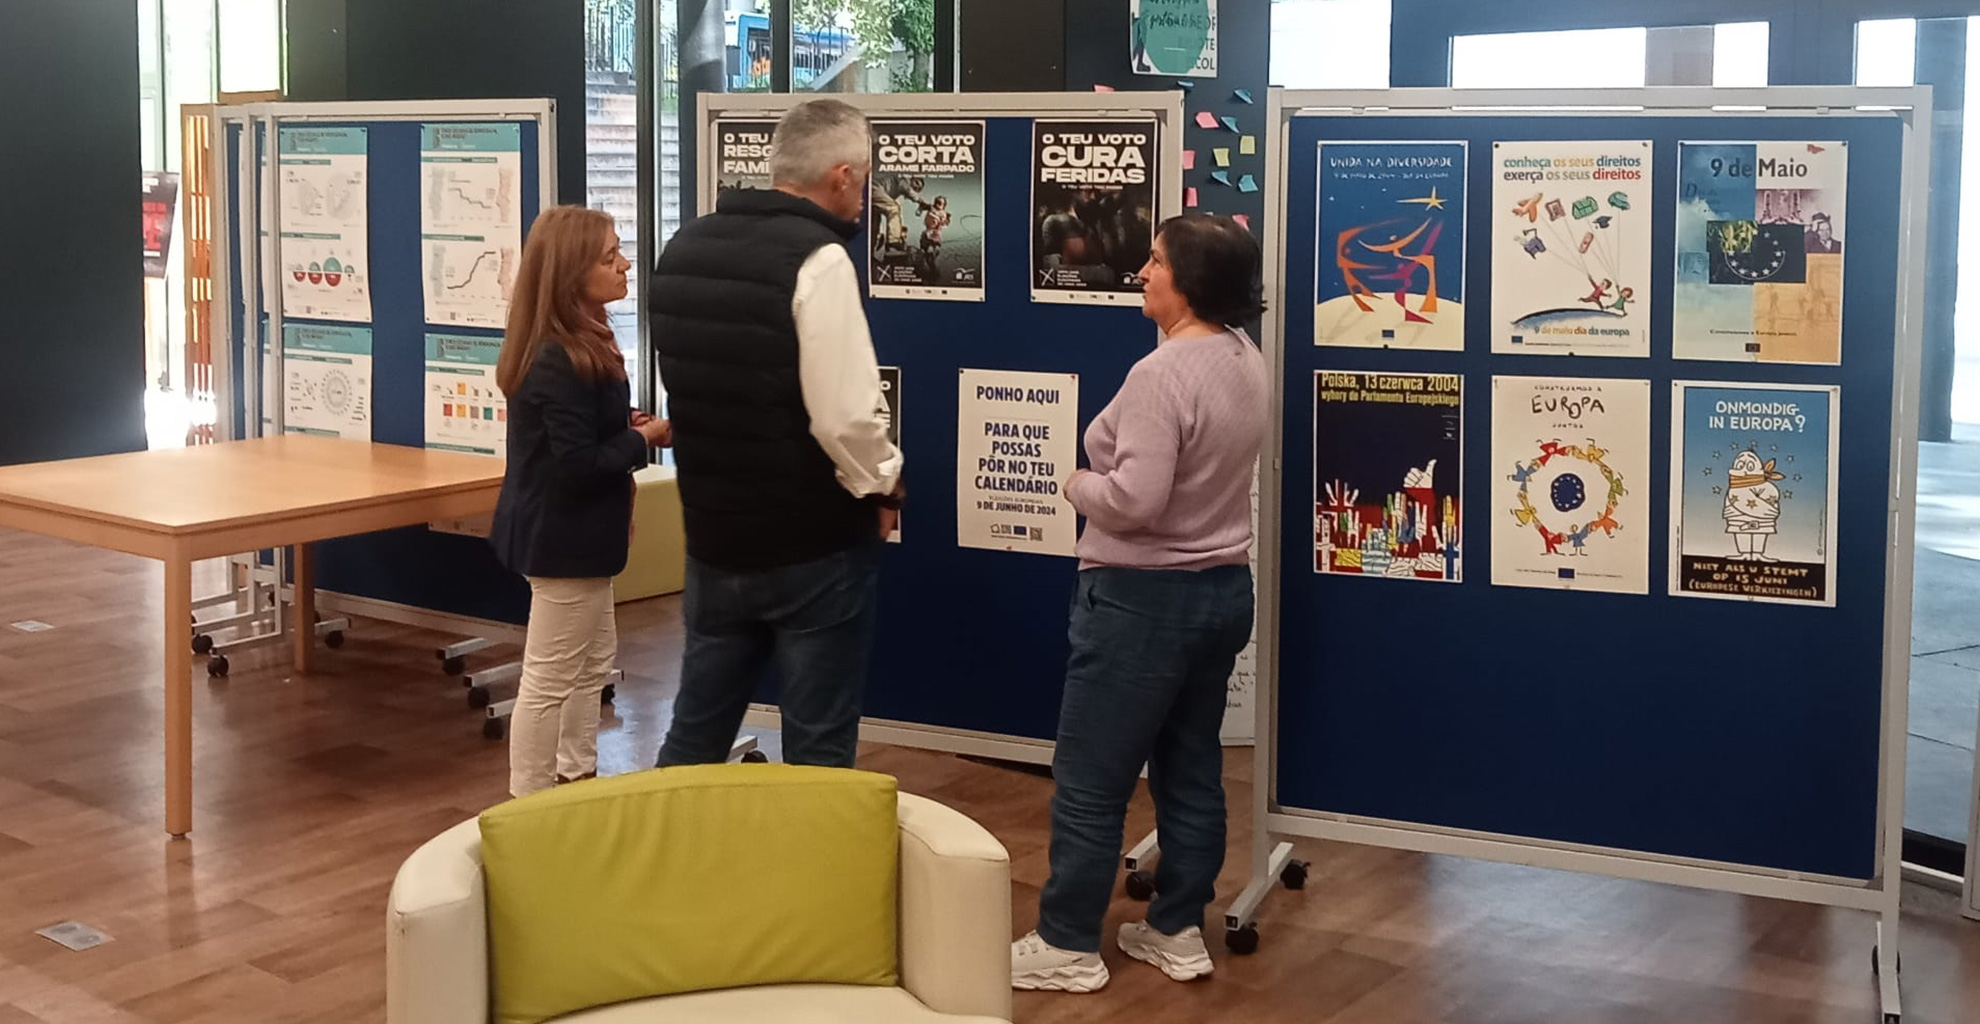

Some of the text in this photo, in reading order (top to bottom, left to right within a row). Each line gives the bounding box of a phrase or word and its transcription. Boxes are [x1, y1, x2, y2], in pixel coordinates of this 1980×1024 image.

[723, 133, 769, 144] O TEU
[878, 134, 976, 146] O TEU VOTO
[1042, 133, 1147, 145] O TEU VOTO
[723, 144, 774, 158] RESG
[878, 145, 976, 164] CORTA
[1041, 145, 1146, 168] CURA
[723, 157, 770, 174] FAMÍ
[878, 164, 976, 173] ARAME FARPADO
[1330, 157, 1453, 168] UNIDA NA DIVERSIDADE
[1503, 155, 1642, 171] conheça os seus direitos
[1710, 157, 1808, 178] 9 de Maio
[1041, 167, 1146, 184] FERIDAS
[1503, 168, 1642, 184] exerça os seus direitos
[1574, 325, 1588, 335] dia
[1588, 326, 1599, 336] da
[1600, 327, 1631, 337] europa
[1321, 372, 1460, 392] Polska, 13 czerwca 2004
[976, 385, 1060, 406] PONHO AQUI
[1531, 394, 1605, 420] EUROPA
[1715, 400, 1800, 416] ONMONDIG
[1708, 415, 1725, 429] IN
[984, 421, 1050, 441] PARA QUE
[992, 440, 1043, 458] POSSAS
[1008, 459, 1028, 475] NO
[1029, 460, 1055, 477] TEU
[974, 475, 1059, 496] CALENDÁRIO
[976, 500, 1057, 516] 9 DE JUNHO DE 2024
[1693, 561, 1720, 572] NIET
[1724, 563, 1746, 573] ALS
[1763, 566, 1809, 577] STEMT
[1712, 572, 1730, 581] OP
[1754, 575, 1788, 585] JUNI
